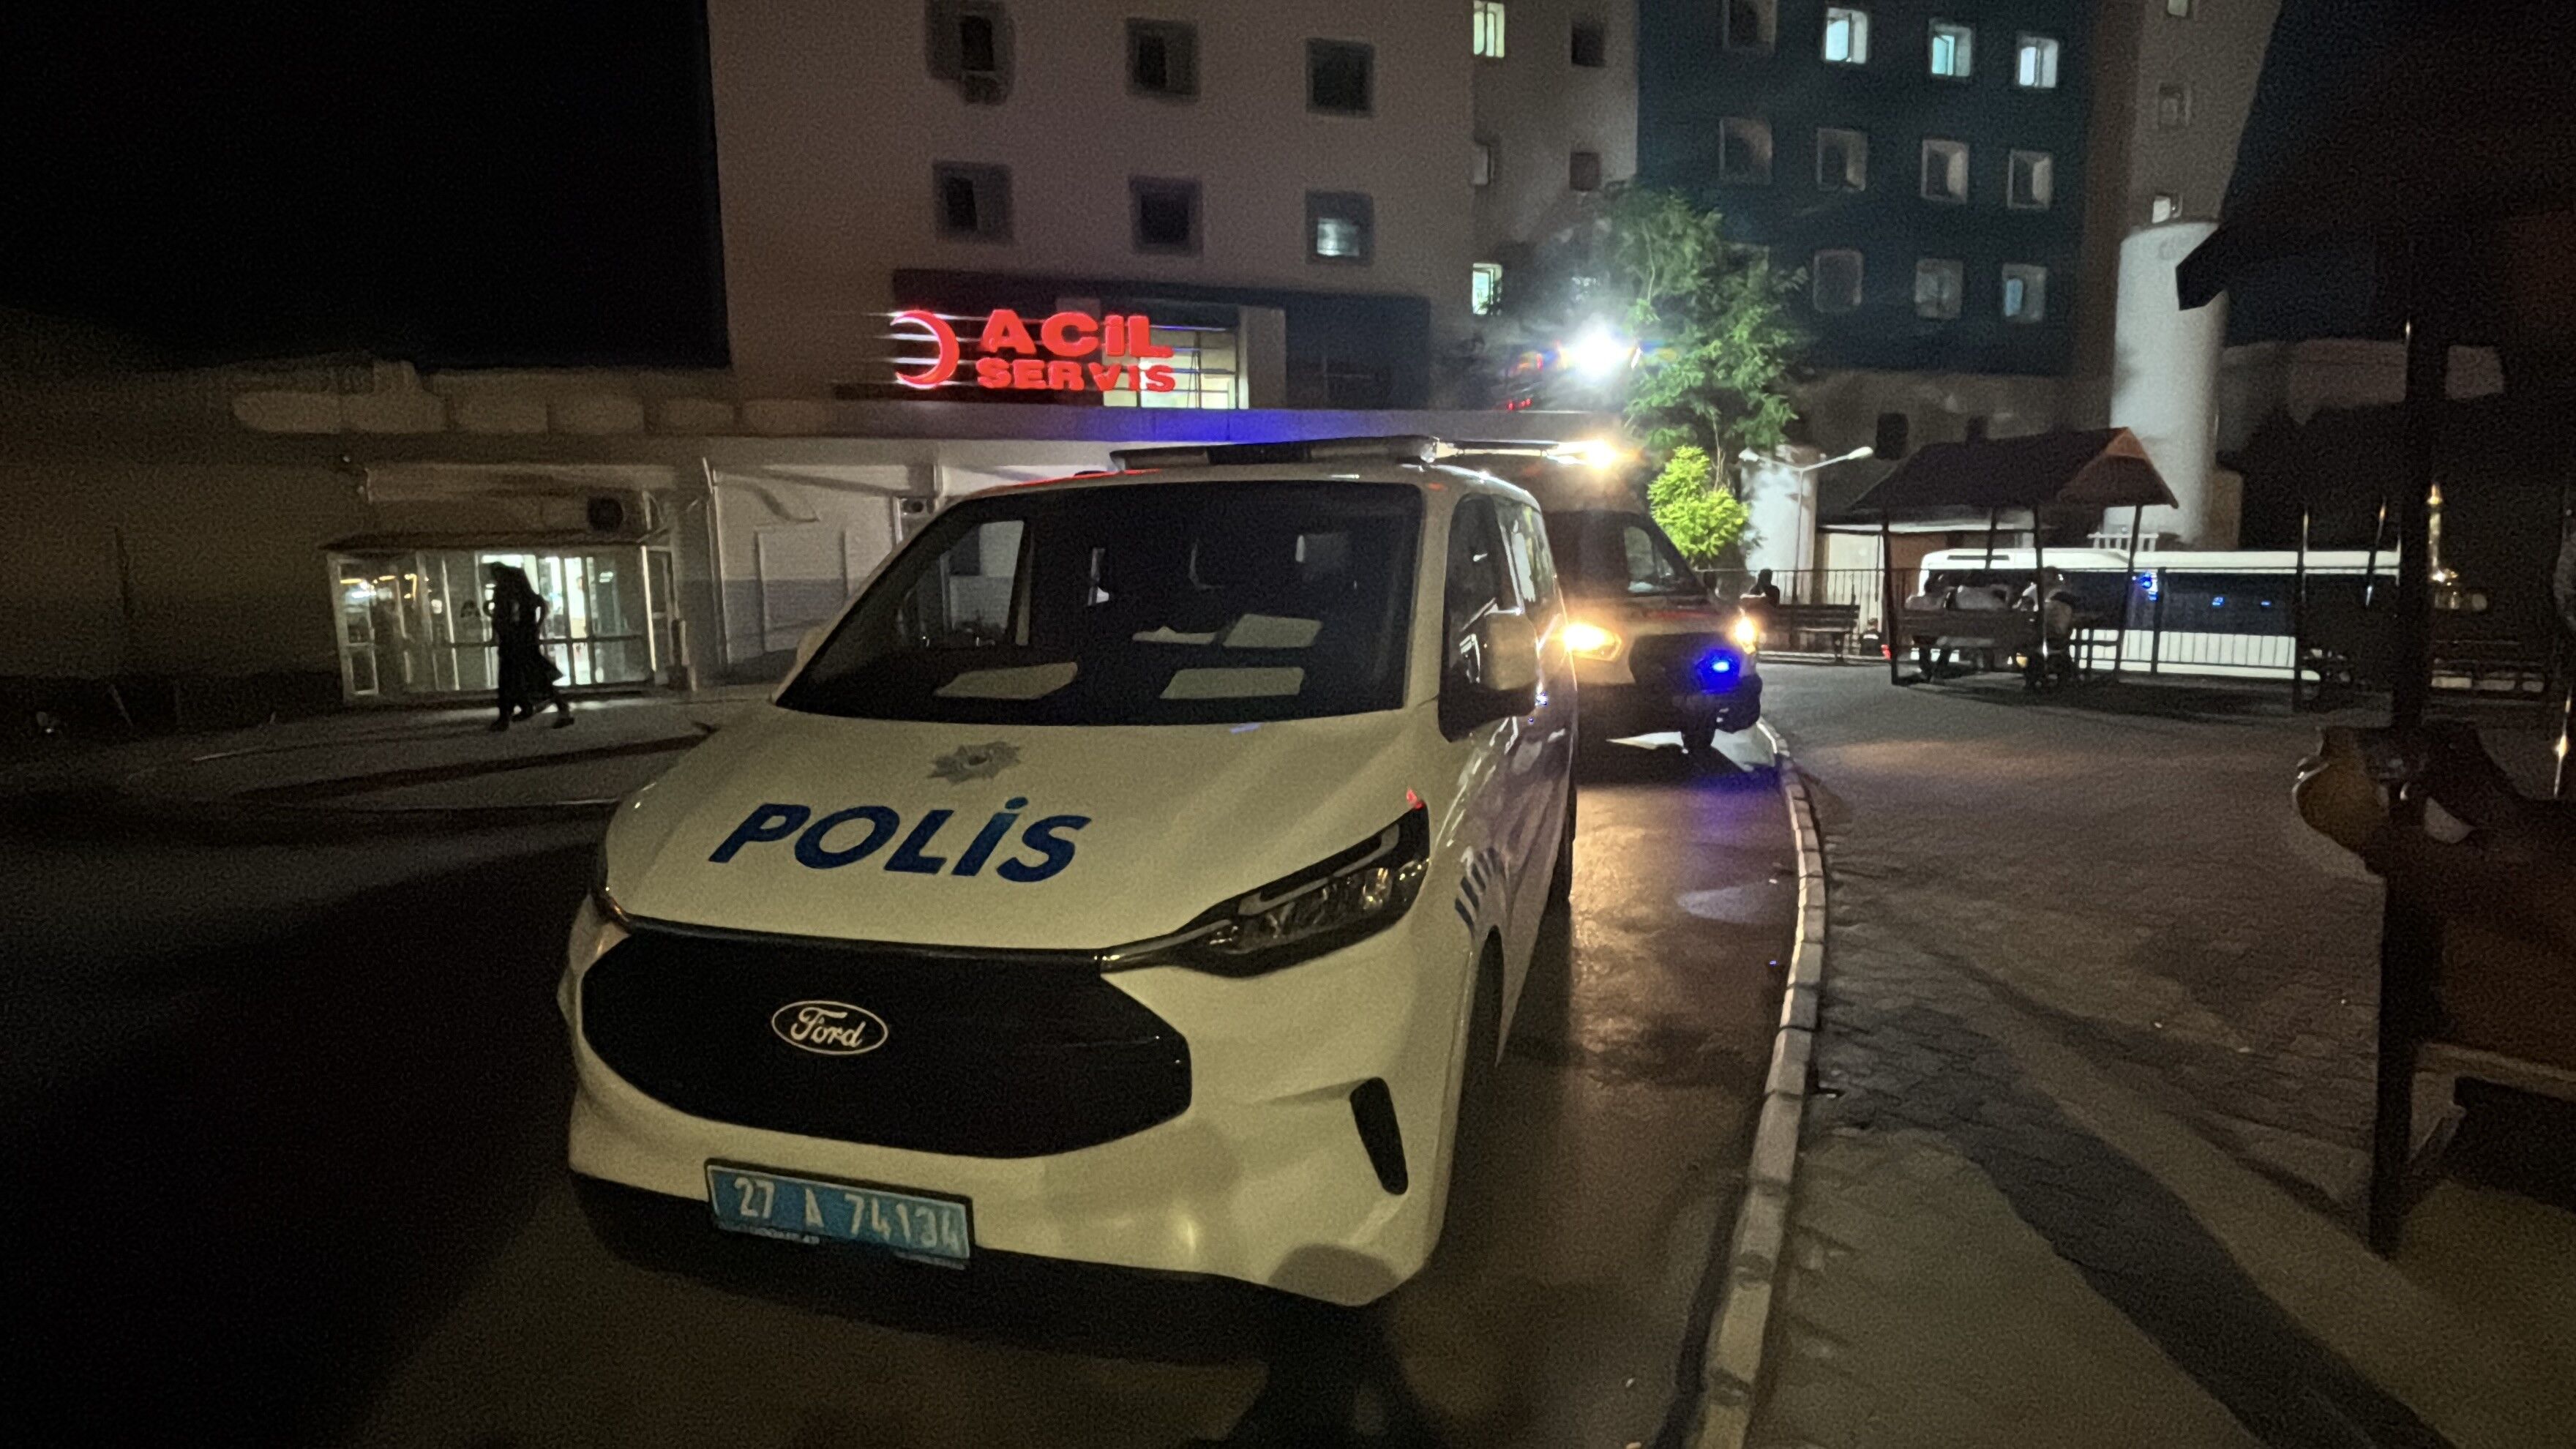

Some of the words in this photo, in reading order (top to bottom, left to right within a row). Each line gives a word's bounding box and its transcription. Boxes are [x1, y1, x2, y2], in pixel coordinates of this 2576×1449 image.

[790, 1006, 866, 1048] Ford
[734, 1177, 775, 1219] 27
[804, 1187, 825, 1228] A
